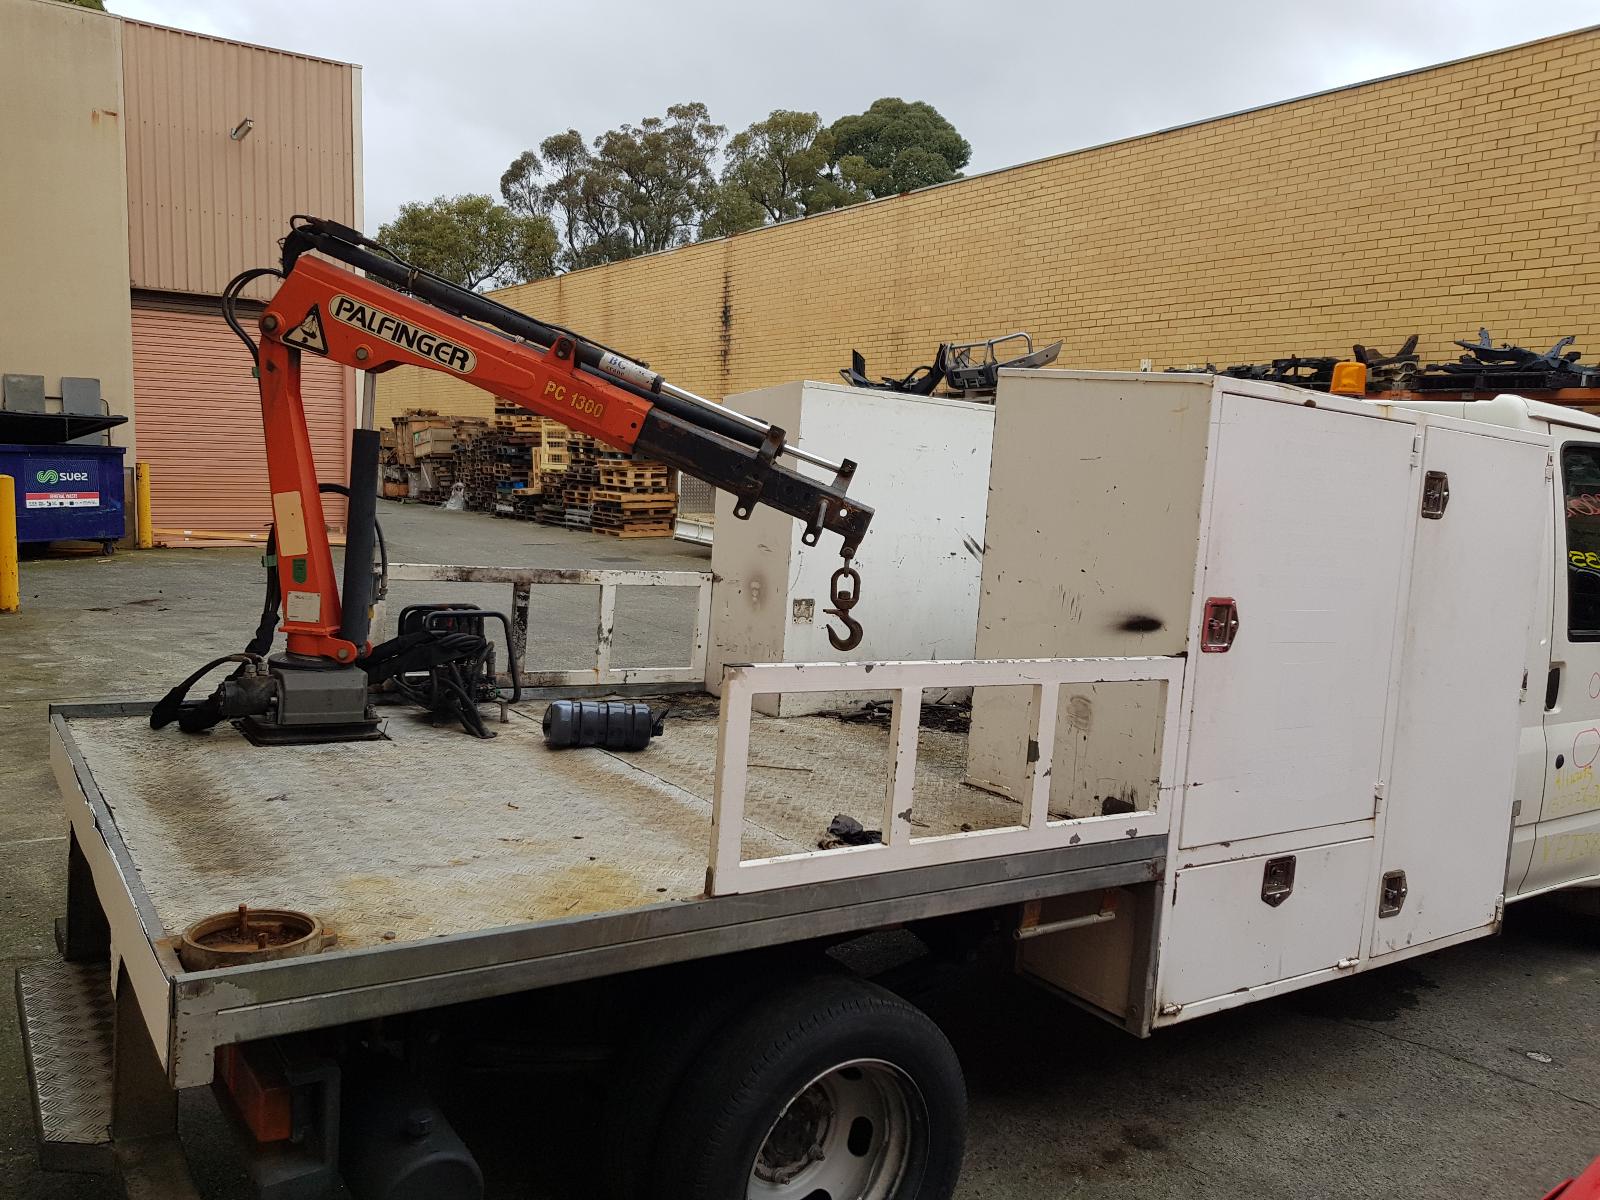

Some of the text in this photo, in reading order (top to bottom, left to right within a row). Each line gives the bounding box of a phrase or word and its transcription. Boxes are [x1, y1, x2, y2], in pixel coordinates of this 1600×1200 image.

[334, 297, 470, 371] PALFINGER
[544, 380, 604, 418] PC 1300
[60, 472, 88, 481] suez
